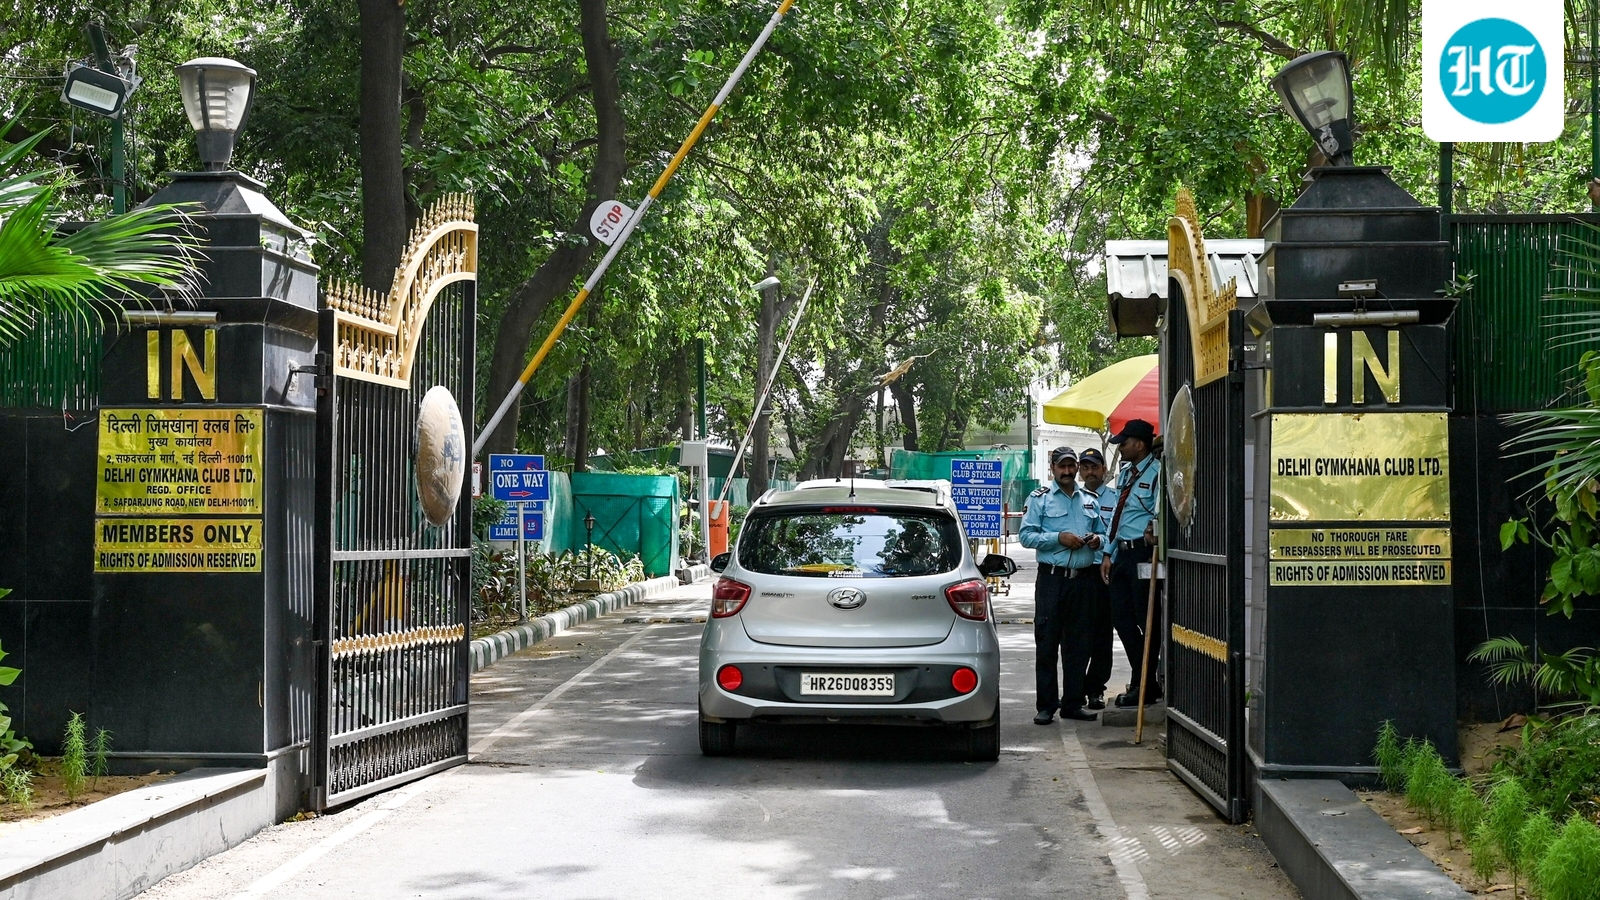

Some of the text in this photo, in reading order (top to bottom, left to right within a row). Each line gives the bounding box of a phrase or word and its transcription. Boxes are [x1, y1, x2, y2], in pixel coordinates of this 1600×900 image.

[596, 204, 623, 238] STOP
[146, 329, 216, 400] IN
[1324, 330, 1400, 404] IN
[107, 413, 141, 434] दिल्ली
[146, 413, 199, 434] जिमखाना
[203, 418, 230, 434] क्लब
[148, 434, 212, 451] मुख्य कार्यालय
[182, 450, 195, 465] नई
[500, 459, 514, 468] NO
[960, 462, 994, 470] CAR WITH
[1278, 458, 1443, 476] DELHI GYMKHANA CLUB LTD.
[104, 468, 255, 483] DELHI GYMKHANA CLUB LTD.
[496, 473, 545, 488] ONE WAY
[952, 470, 1001, 479] CLUB STICKER
[146, 486, 211, 495] REGD. OFFICE
[952, 488, 1001, 497] CAR WITHOUT
[113, 498, 162, 507] SAFDARJUNG
[207, 498, 255, 507] DELHI-110011
[952, 496, 1000, 505] CLUB STICKER
[103, 524, 253, 543] MEMBERS ONLY
[495, 527, 519, 536] LIMIT
[1311, 531, 1408, 542] NO THOROUGH FARE
[1279, 545, 1441, 556] TRESPASSERS WILL BE PROSECUTED
[100, 552, 256, 568] RIGHTS OF ADMISSION RESERVED
[1276, 564, 1446, 582] RIGHTS OF ADMISSION RESERVED
[810, 677, 893, 691] HR26DQ8359
